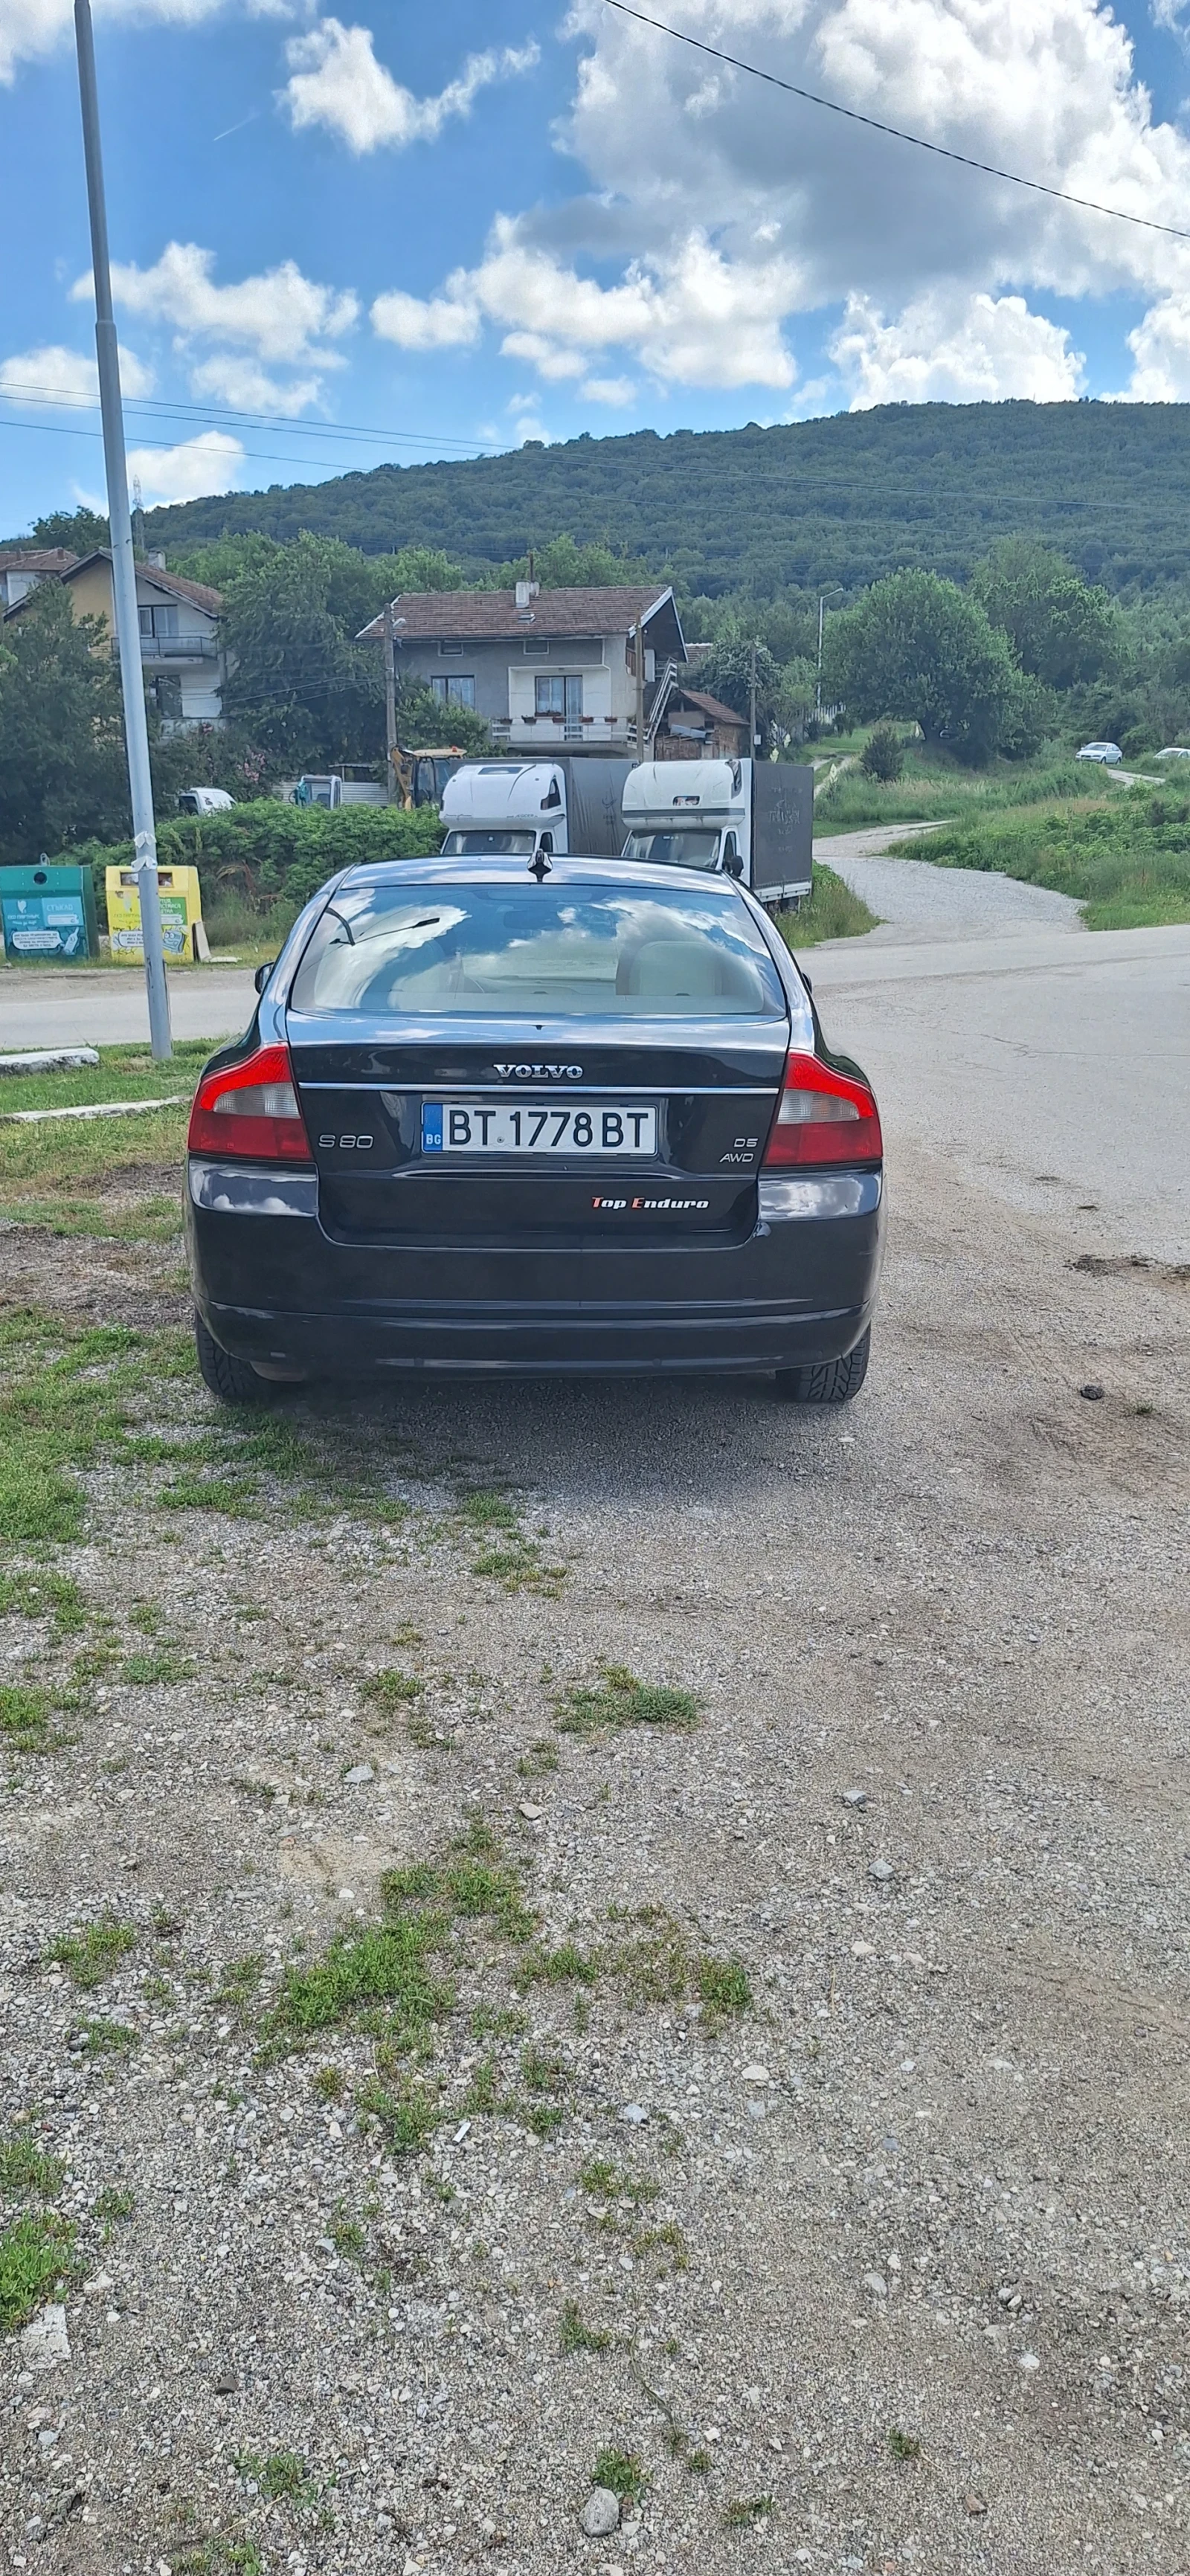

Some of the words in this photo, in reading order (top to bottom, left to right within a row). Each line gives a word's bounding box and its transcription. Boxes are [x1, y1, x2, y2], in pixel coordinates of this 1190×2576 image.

[493, 1064, 583, 1079] VOLVO
[449, 1110, 496, 1146] BT
[509, 1111, 594, 1147] 1778
[602, 1112, 649, 1147] BT
[425, 1134, 442, 1145] BG
[733, 1138, 759, 1147] D5
[719, 1153, 754, 1162] AWD
[592, 1197, 627, 1210] Top
[631, 1197, 710, 1209] Enduro
